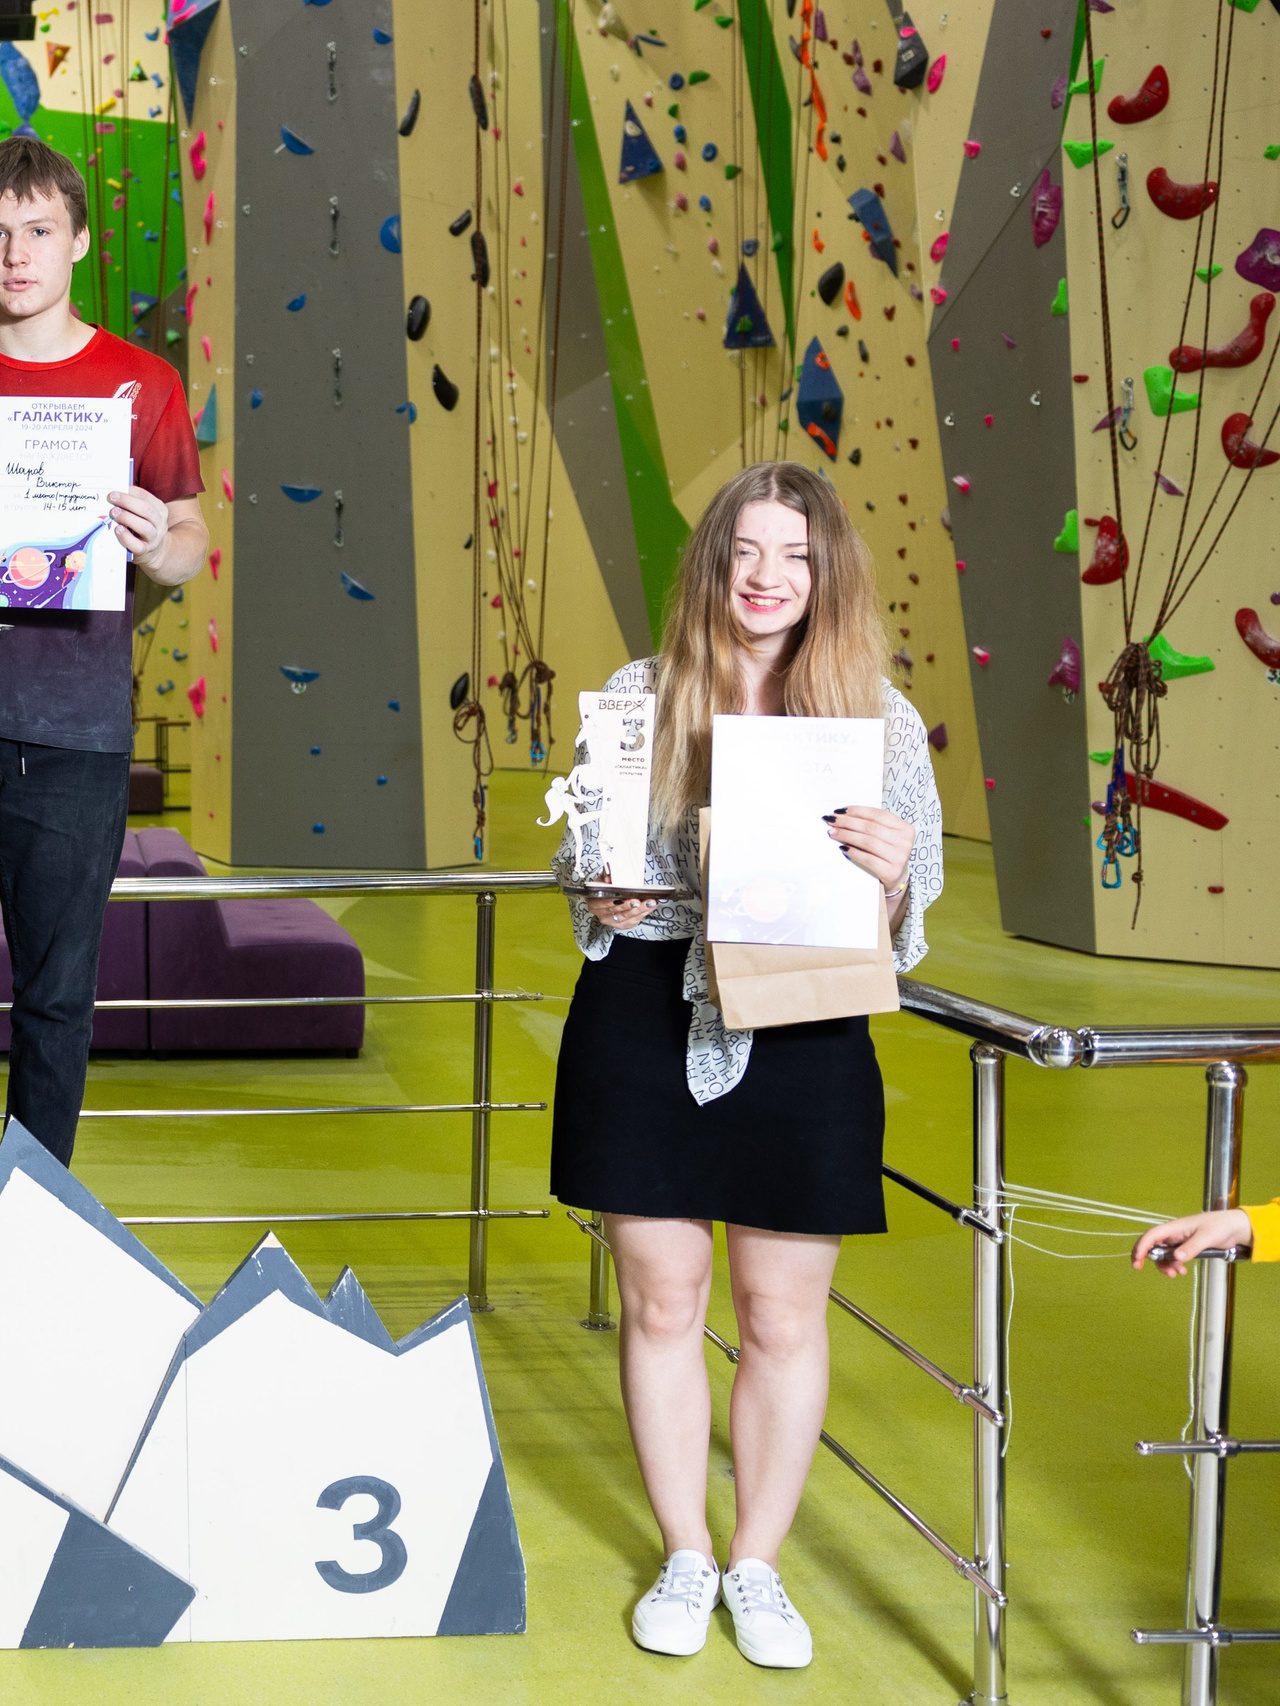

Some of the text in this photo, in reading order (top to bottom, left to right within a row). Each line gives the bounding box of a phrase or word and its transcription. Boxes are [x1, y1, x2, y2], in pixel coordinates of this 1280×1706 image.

[31, 402, 86, 411] ОТКРЫВАЕМ
[7, 411, 108, 424] «ГАЛАКТИКУ»
[74, 424, 94, 432] 2024
[24, 439, 89, 451] ГРАМОТА
[598, 696, 648, 716] ВВЕРХ
[620, 718, 646, 752] 3
[314, 1474, 409, 1595] 3
